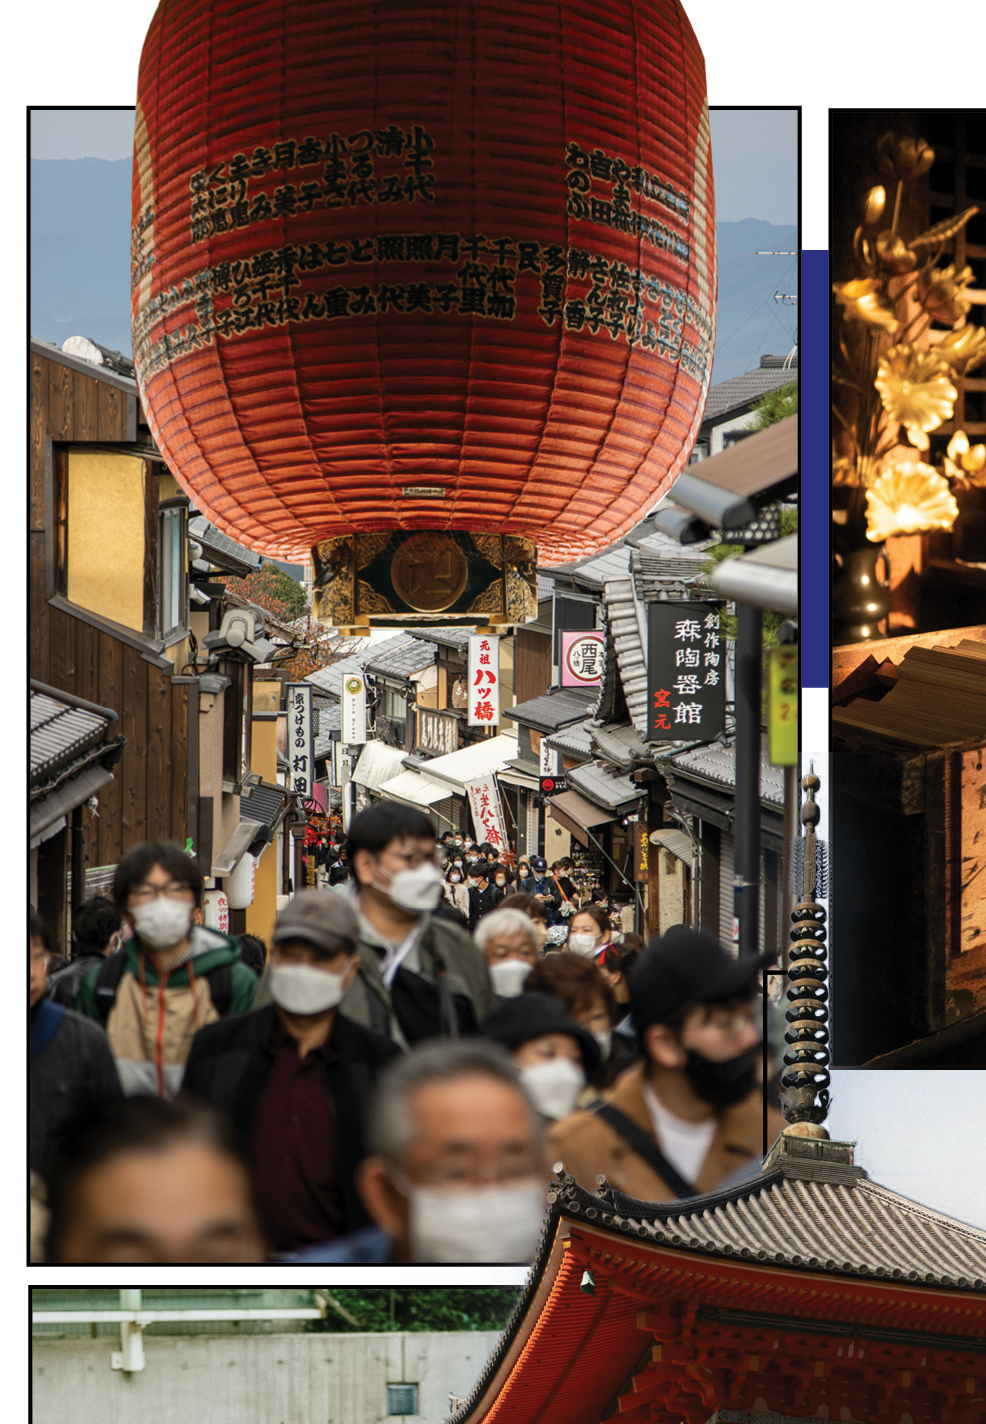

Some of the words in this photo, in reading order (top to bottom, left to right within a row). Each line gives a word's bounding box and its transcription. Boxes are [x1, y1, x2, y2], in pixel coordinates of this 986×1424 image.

[579, 643, 598, 675] 西尾
[703, 612, 720, 687] 創作陶房
[294, 692, 306, 748] 京つけもの
[653, 688, 672, 730] 窯元
[293, 754, 308, 793] 打田
